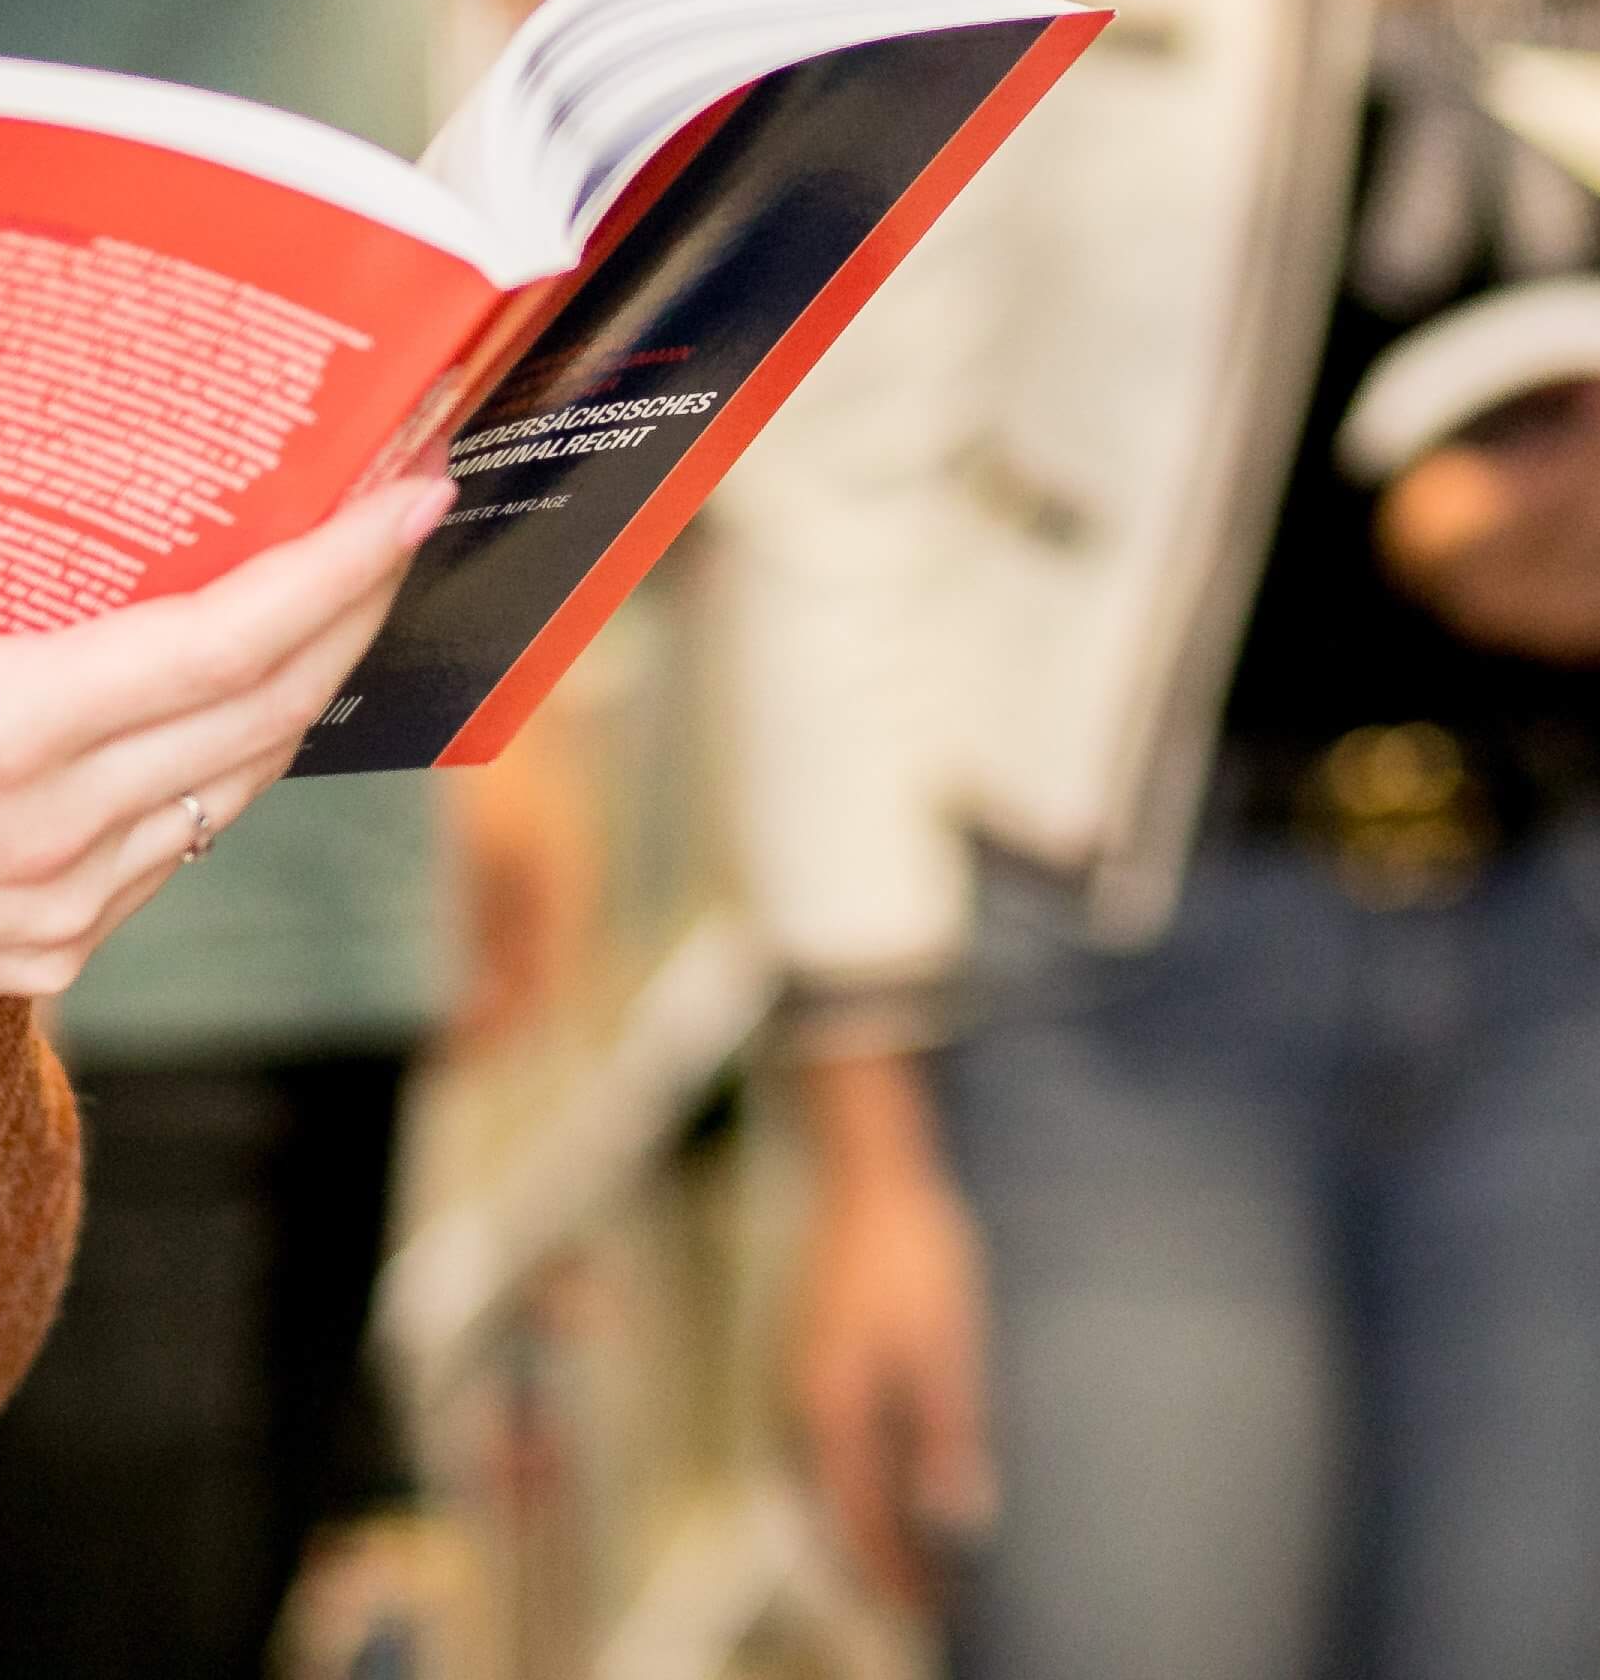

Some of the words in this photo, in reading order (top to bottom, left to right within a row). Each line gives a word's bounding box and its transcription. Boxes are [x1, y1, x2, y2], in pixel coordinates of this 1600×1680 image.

[448, 391, 719, 458] NIEDERSÄCHSISCHES
[446, 425, 657, 480] OMMUNALRECHT
[498, 494, 573, 516] AUFLAGE
